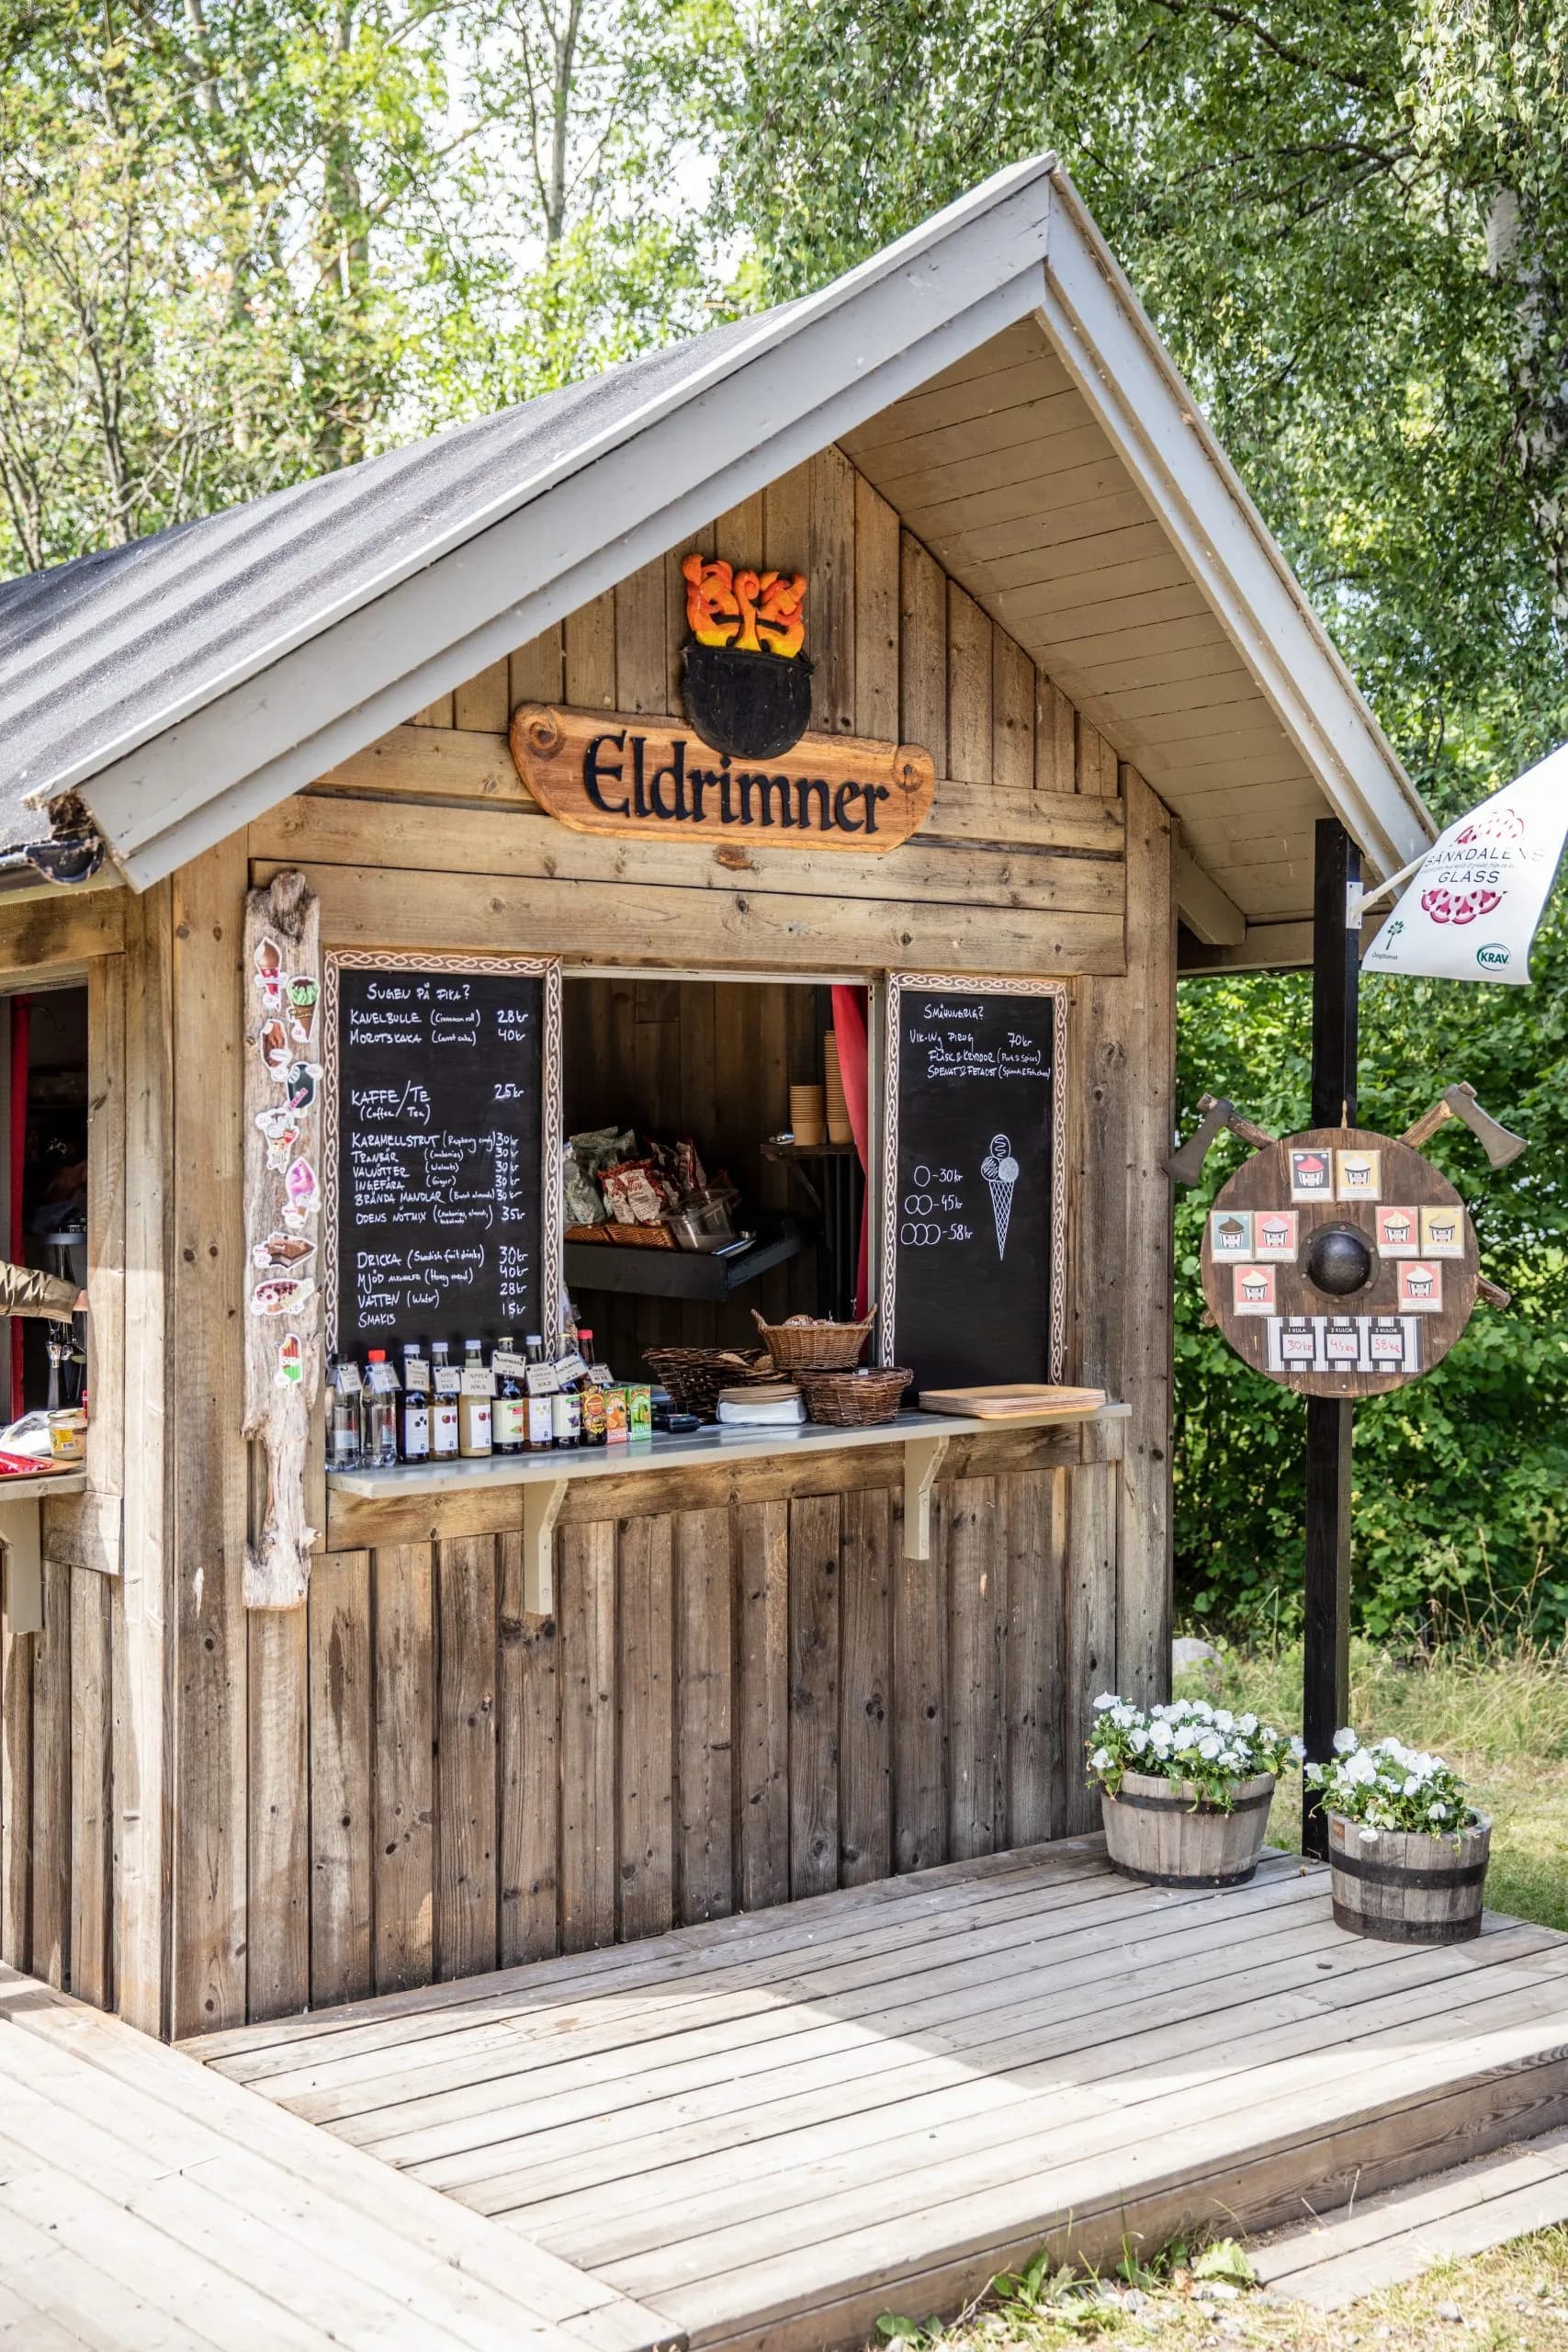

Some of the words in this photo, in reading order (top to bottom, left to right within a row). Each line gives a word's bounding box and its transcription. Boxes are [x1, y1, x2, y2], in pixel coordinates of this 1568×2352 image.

[583, 729, 890, 834] Eldrimner
[1438, 870, 1500, 883] GLASS
[1480, 952, 1509, 964] KRAV
[367, 982, 411, 1000] SUGEN
[416, 982, 431, 1001] PÅ
[350, 1009, 423, 1025] KANELBULLE
[350, 1029, 423, 1045] MOROTSKAKA
[947, 1032, 974, 1053] PIROG
[927, 1064, 958, 1079] SPENAT
[352, 1132, 441, 1148] KARAMELLSTRUT
[351, 1148, 399, 1163] TRANBÄR
[355, 1176, 405, 1191] INGEFÄRA
[354, 1191, 395, 1206] BRÄNDA
[400, 1191, 446, 1204] MANDLAR
[356, 1213, 387, 1225] ODENS
[392, 1205, 426, 1224] NÖTMIX
[356, 1251, 402, 1269] DRICKA
[357, 1269, 384, 1294] MJÖD
[357, 1290, 400, 1308] VATTEN
[407, 1289, 439, 1308] (Water)
[358, 1312, 396, 1328] SMAKIS
